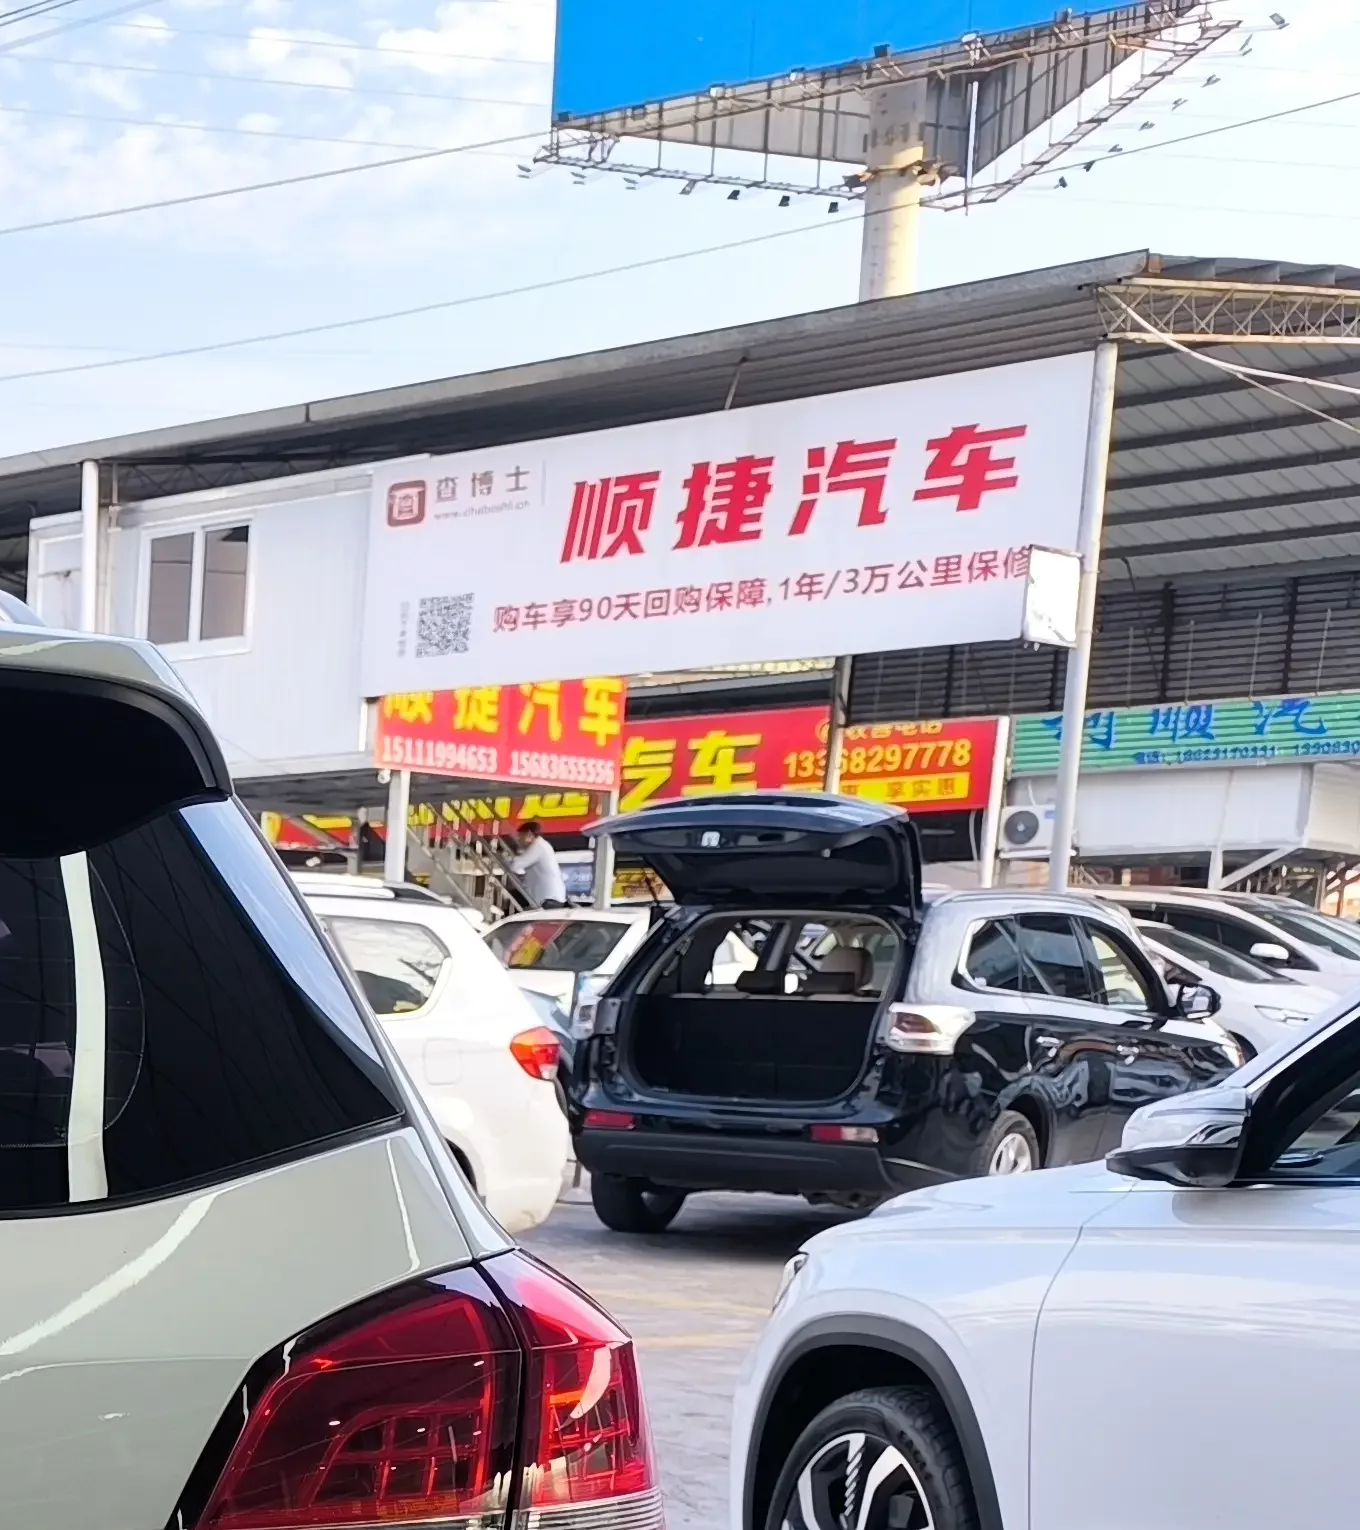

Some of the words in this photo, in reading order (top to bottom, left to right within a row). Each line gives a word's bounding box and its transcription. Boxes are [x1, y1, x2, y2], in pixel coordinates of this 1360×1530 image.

[436, 464, 531, 503] 查博士
[560, 424, 1028, 564] 顺捷汽车
